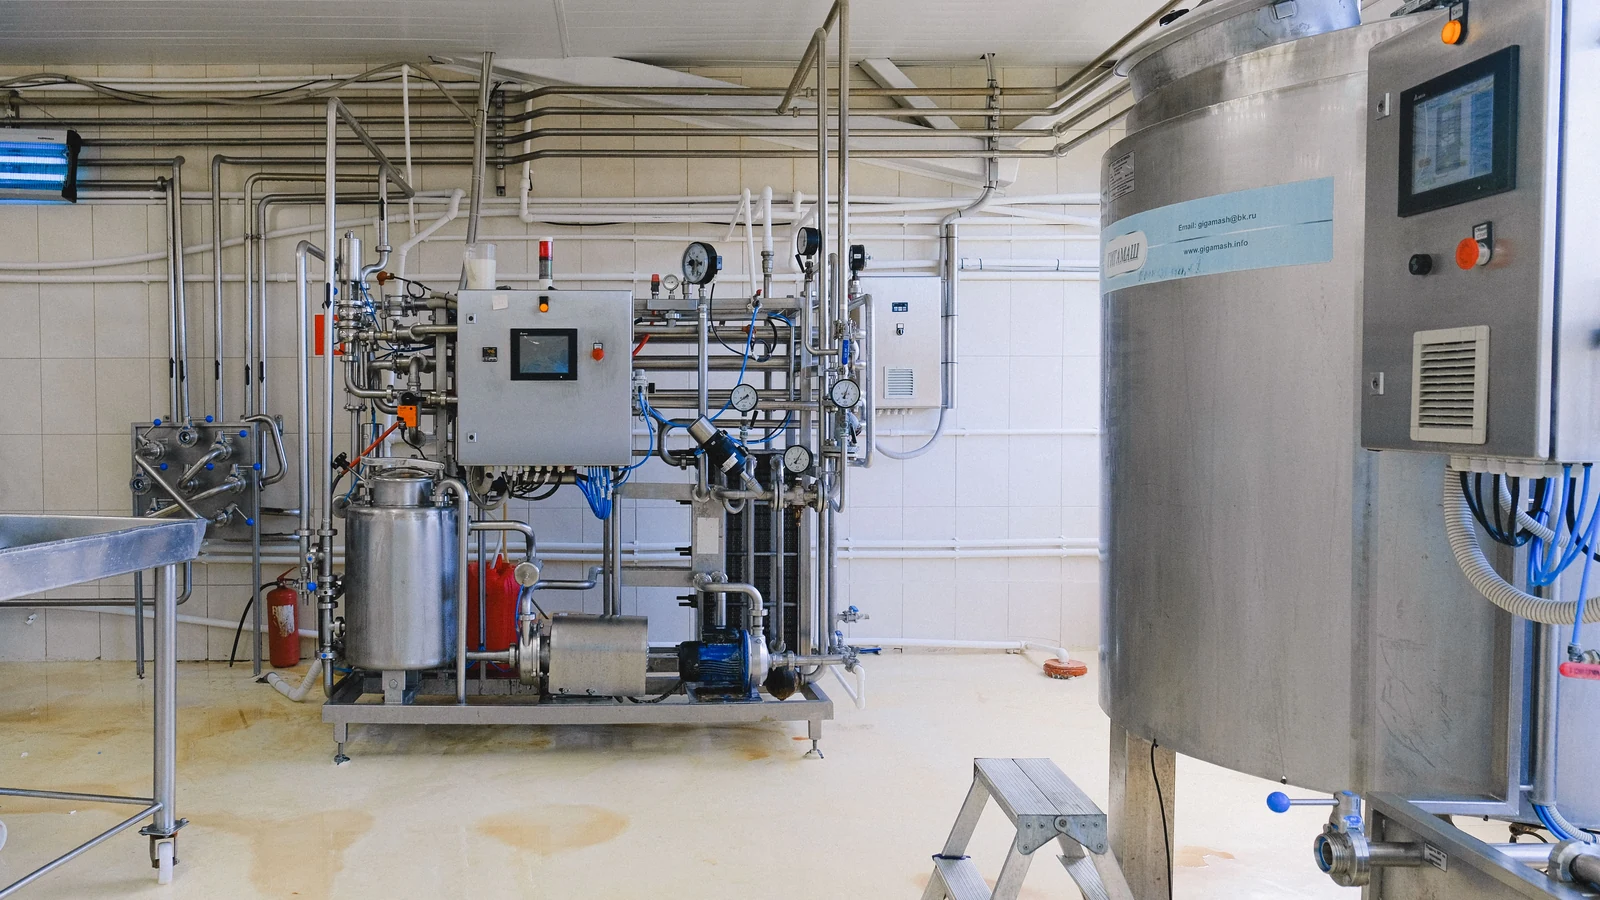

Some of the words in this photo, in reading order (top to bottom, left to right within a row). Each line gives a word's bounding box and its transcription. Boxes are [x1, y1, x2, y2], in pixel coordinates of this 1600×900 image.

[1178, 222, 1197, 231] Email:
[1197, 213, 1257, 229] gigamash@bk.ru
[1183, 239, 1249, 255] www.gigamash.info
